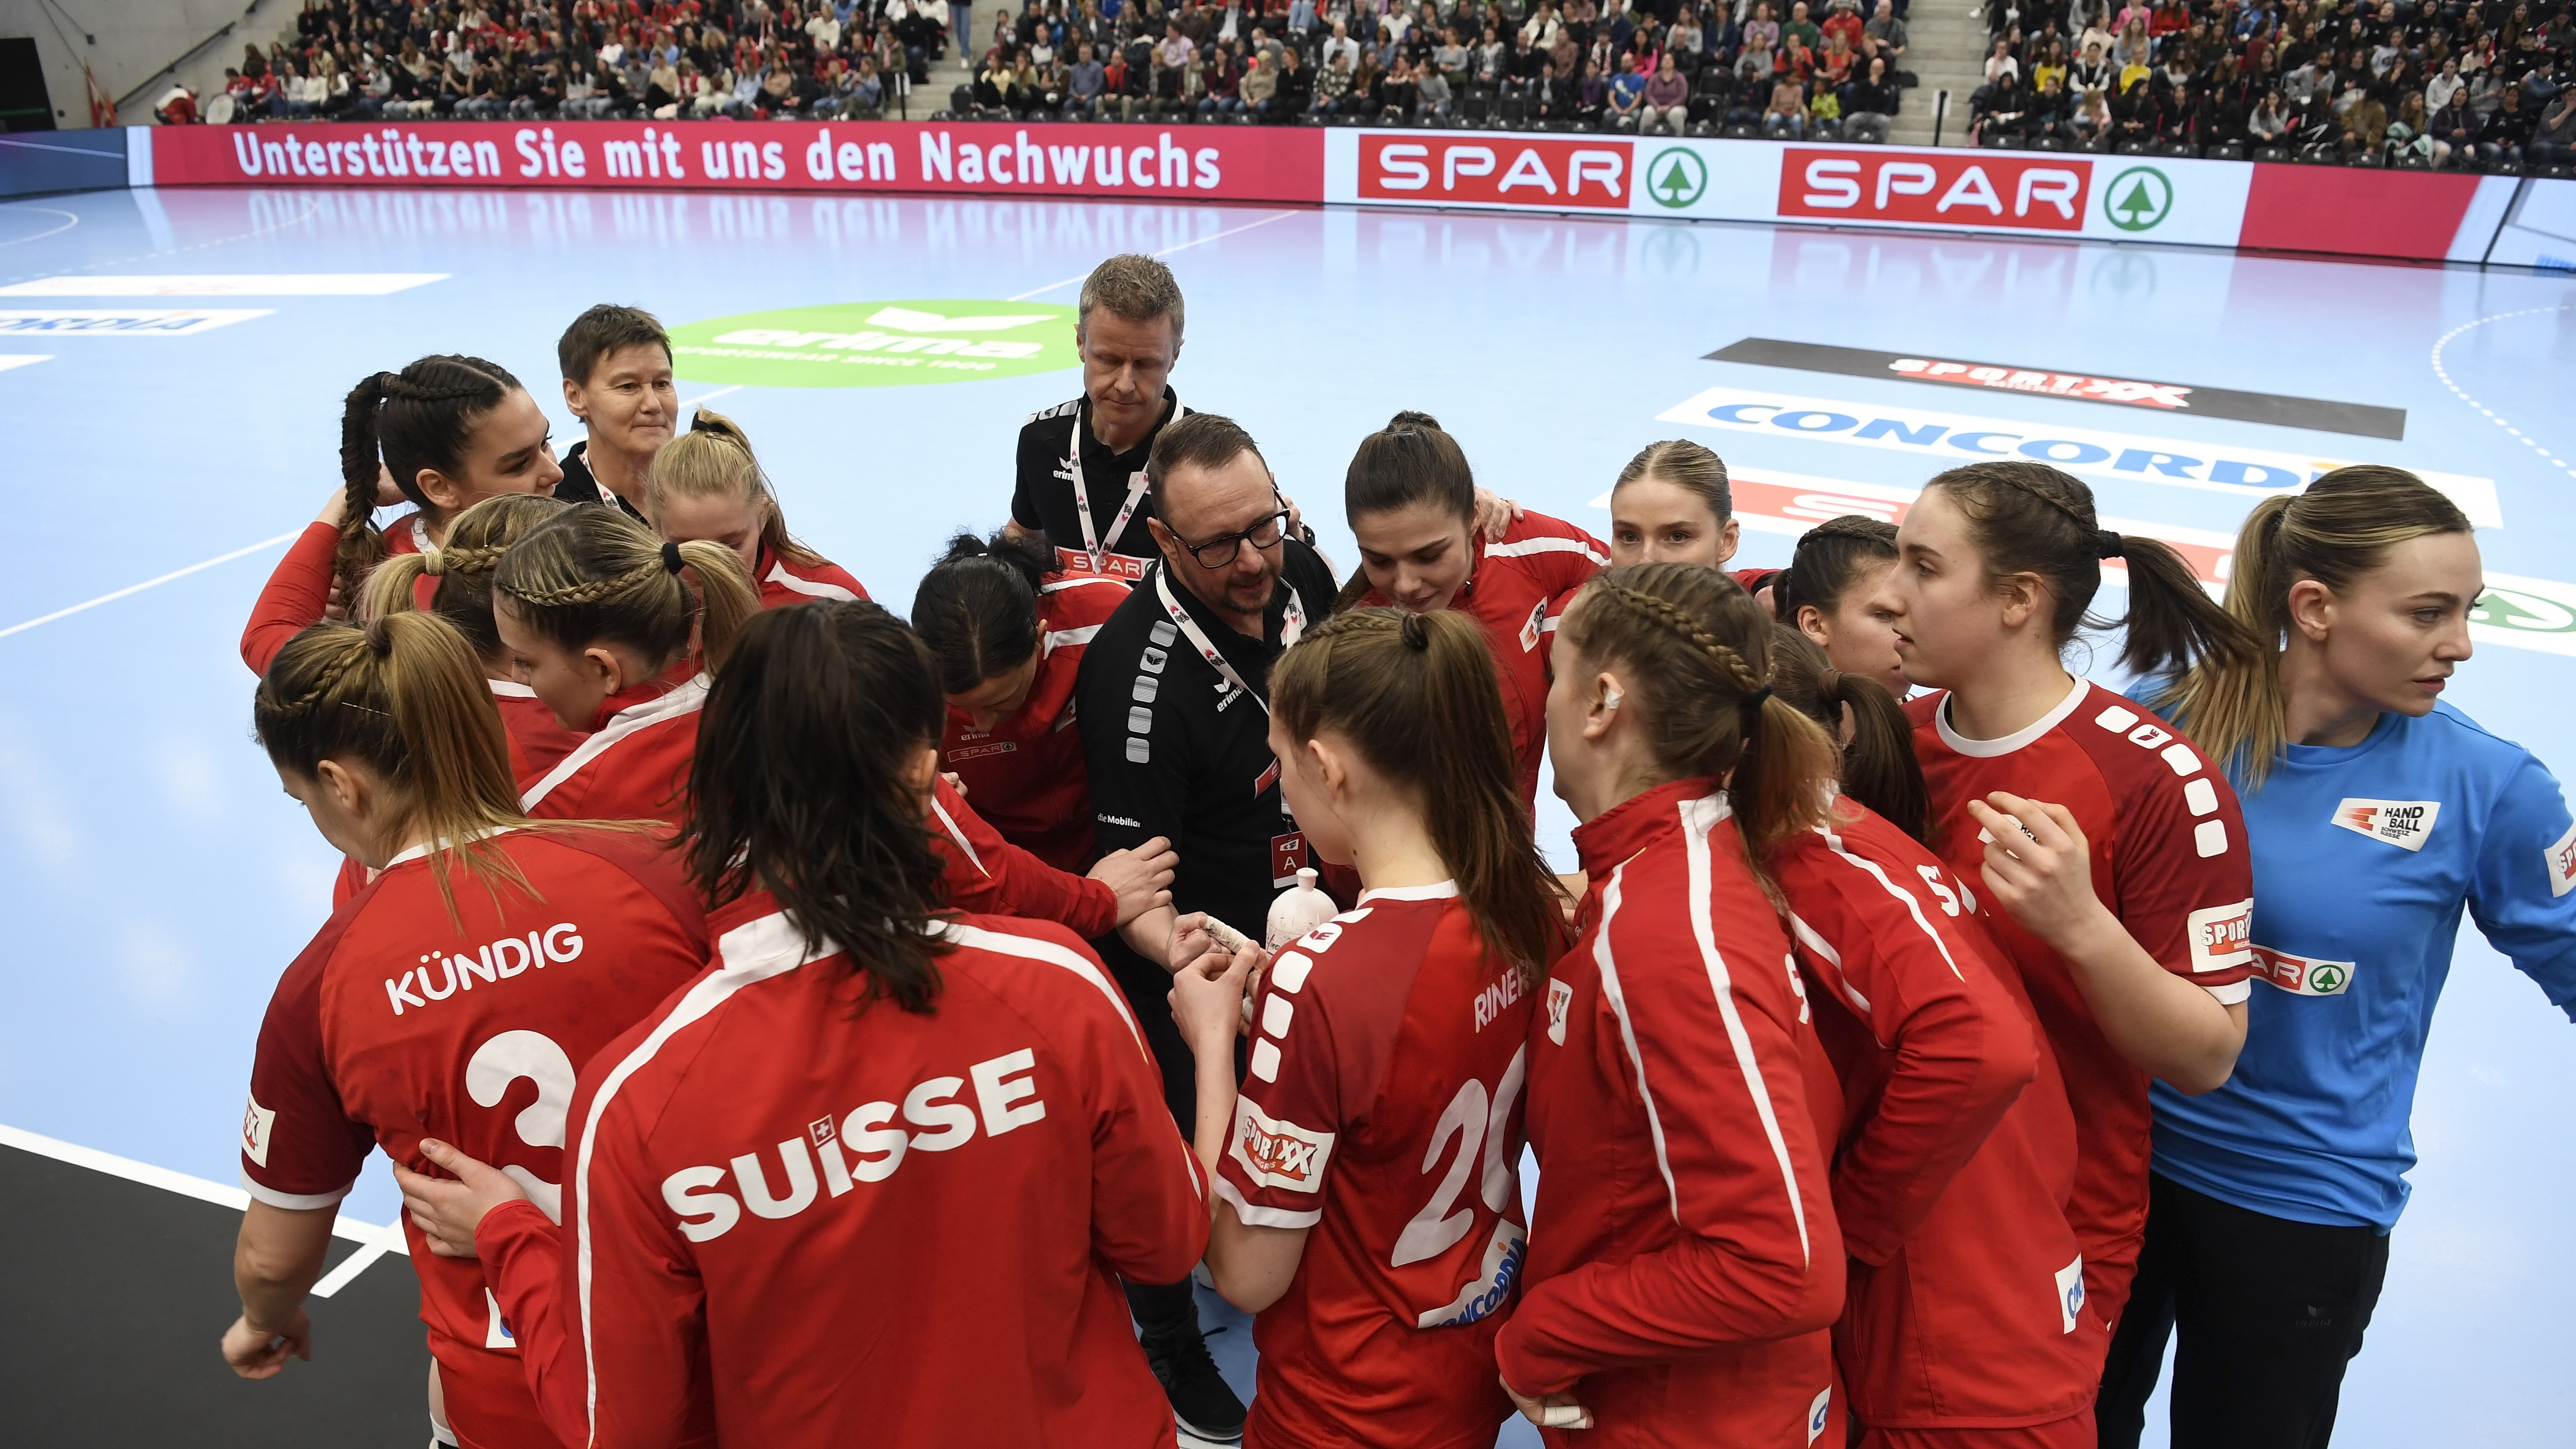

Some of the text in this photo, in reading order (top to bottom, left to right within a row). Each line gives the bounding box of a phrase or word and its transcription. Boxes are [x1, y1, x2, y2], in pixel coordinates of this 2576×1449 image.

[233, 126, 1221, 189] Unterstützen Sie mit uns den Nachwuchs
[1379, 143, 1624, 198] SPAR
[1802, 158, 2081, 220] SPAR
[712, 328, 1044, 359] erima
[841, 354, 924, 366] SINCE
[927, 359, 997, 371] 1900
[1707, 403, 2326, 489] CONCORD
[1053, 470, 1074, 481] erim
[1217, 685, 1245, 712] erima
[960, 745, 1000, 757] SPAR
[1097, 812, 1107, 823] die
[2384, 806, 2425, 819] HAND
[2381, 826, 2410, 836] SCHWEIZ
[2389, 818, 2421, 832] BALL
[2380, 830, 2401, 840] SUISSE
[1283, 856, 1297, 871] A
[385, 923, 583, 1016] KÜNDIG
[1253, 1155, 1276, 1170] MIGRS
